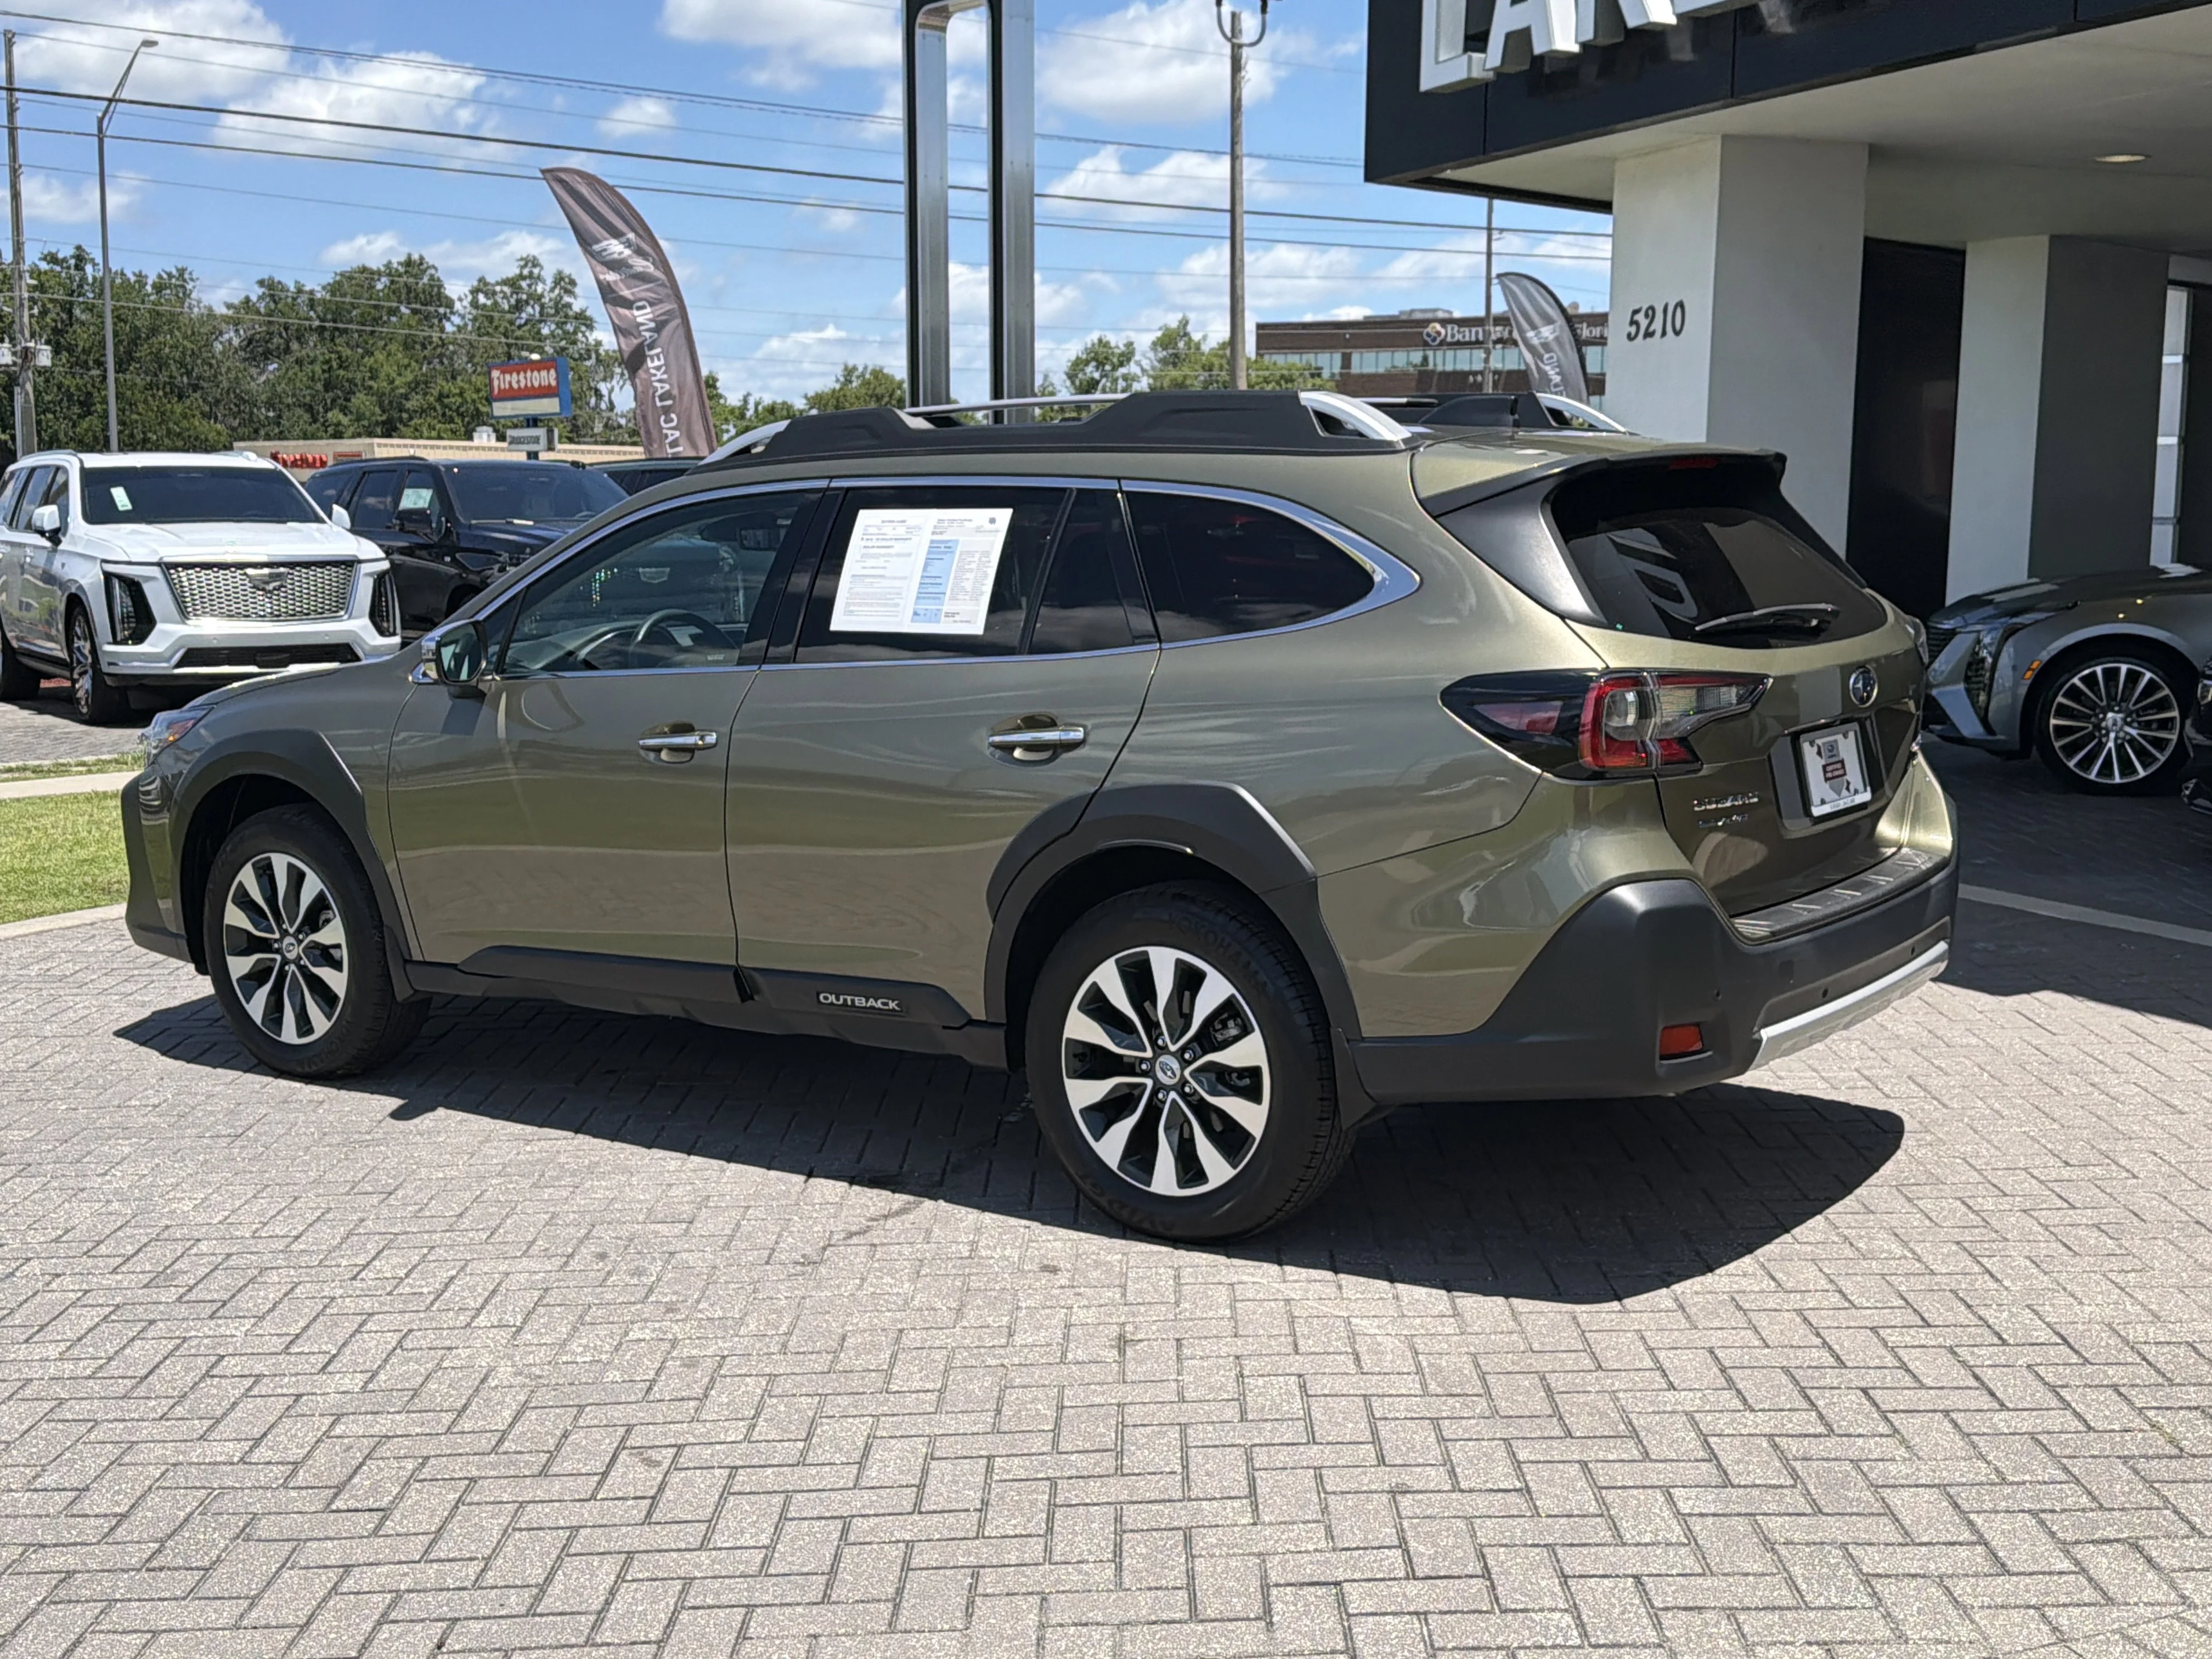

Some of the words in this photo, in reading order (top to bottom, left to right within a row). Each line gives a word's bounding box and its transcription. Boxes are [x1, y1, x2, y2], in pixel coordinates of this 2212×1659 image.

[1626, 299, 1685, 342] 5210
[1446, 324, 1496, 342] Ban
[491, 367, 557, 395] Firestone
[819, 992, 901, 1011] OUTBACK
